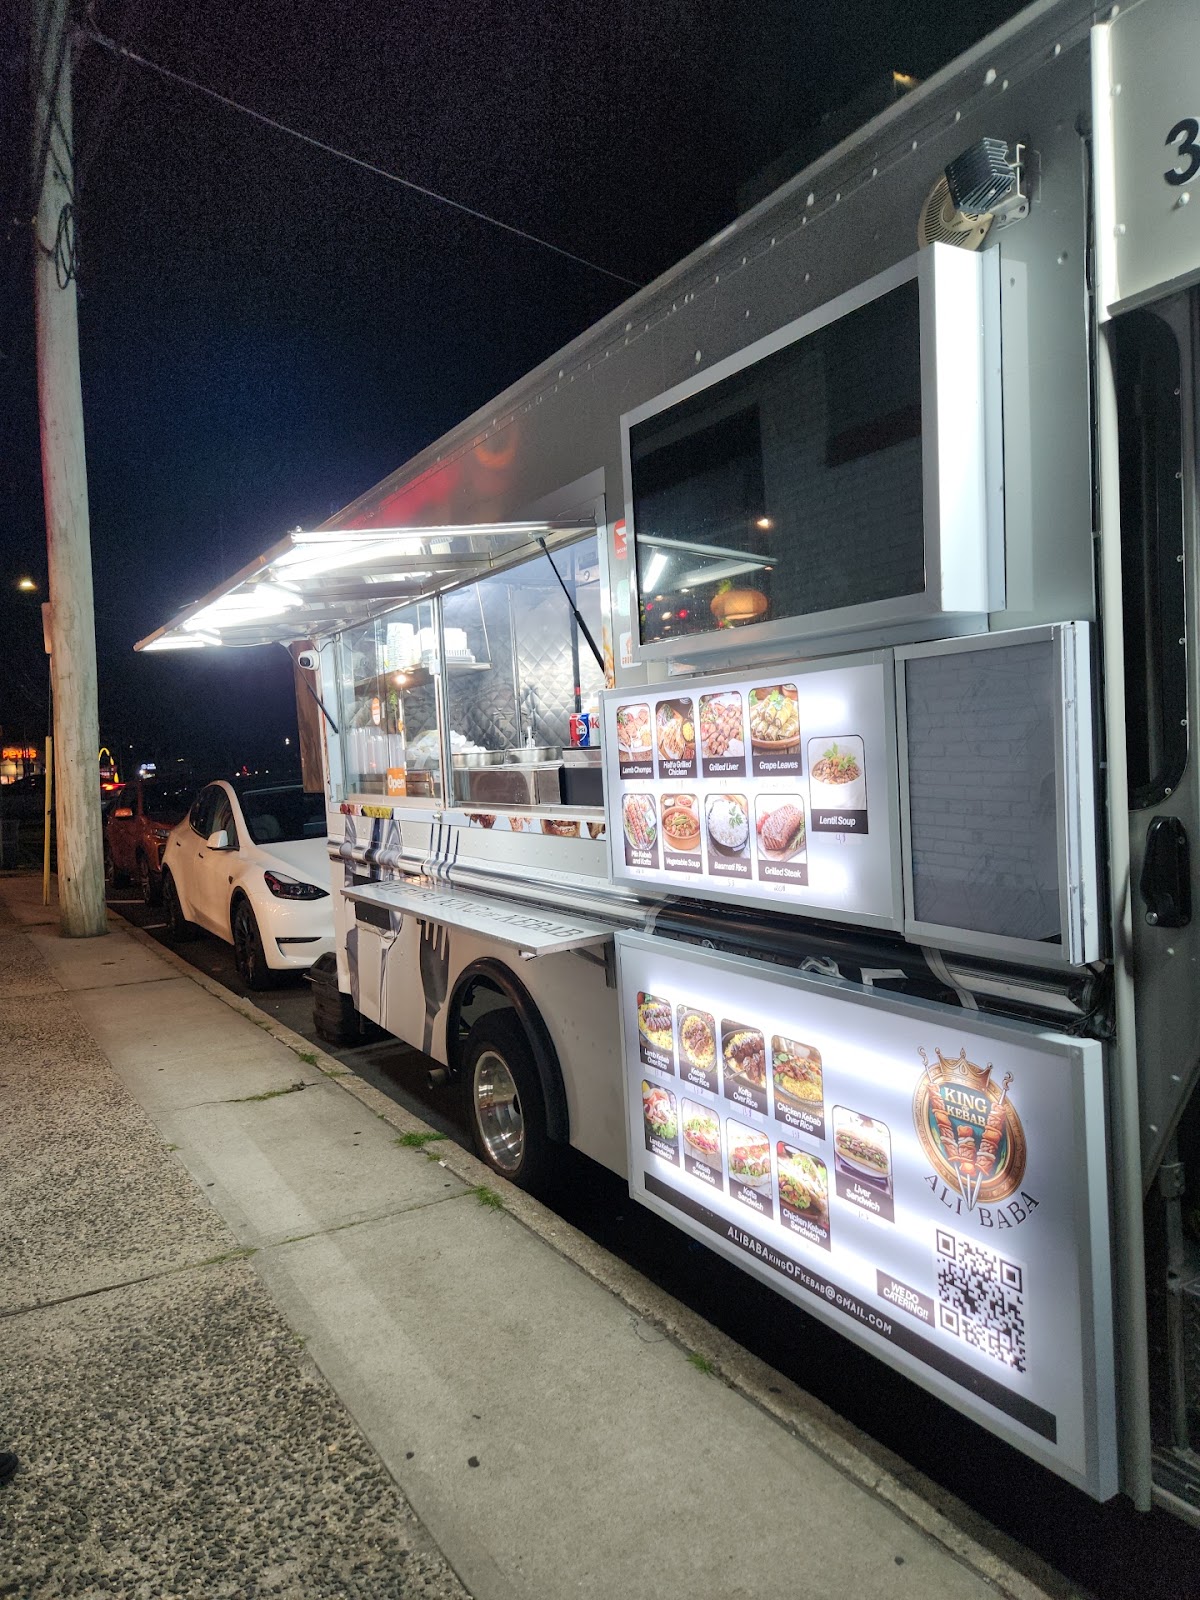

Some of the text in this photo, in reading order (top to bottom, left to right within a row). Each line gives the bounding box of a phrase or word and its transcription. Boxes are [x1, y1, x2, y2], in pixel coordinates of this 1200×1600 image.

[1163, 118, 1200, 186] 3
[677, 760, 692, 768] Grilled
[709, 762, 740, 772] Grilled Liver
[759, 760, 799, 772] Grape Leaves
[668, 768, 688, 776] Chicken
[819, 816, 856, 828] Lentil Soup
[640, 851, 652, 859] Kebab
[665, 857, 701, 868] Vegetable Soup
[714, 862, 748, 872] Basmati Rice
[764, 866, 802, 878] Grilled Steak
[494, 913, 585, 938] KEBAB
[647, 1057, 668, 1070] Over Rice
[656, 1054, 670, 1064] Kebab
[688, 1073, 710, 1088] Over Rice
[691, 1068, 706, 1079] Kebab
[738, 1086, 752, 1098] Kofta
[733, 1092, 758, 1109] Over Rice
[943, 1086, 988, 1114] KING
[777, 1102, 822, 1127] Chicken Kebab
[946, 1104, 986, 1127] KEBAB
[785, 1114, 814, 1132] Over Rice
[652, 1145, 673, 1161] Sandwich
[696, 1161, 711, 1174] Kebab
[692, 1166, 716, 1185] Sandwich
[742, 1186, 758, 1200] Kofta
[854, 1183, 872, 1198] Liver
[737, 1191, 764, 1212] Sandwich
[846, 1188, 880, 1212] Sandwich
[923, 1173, 1040, 1230] ALI BABA
[782, 1208, 828, 1239] Chicken Kebab
[790, 1221, 820, 1244] Sandwich
[890, 1281, 920, 1303] WE DO
[883, 1287, 929, 1321] CATERING!!
